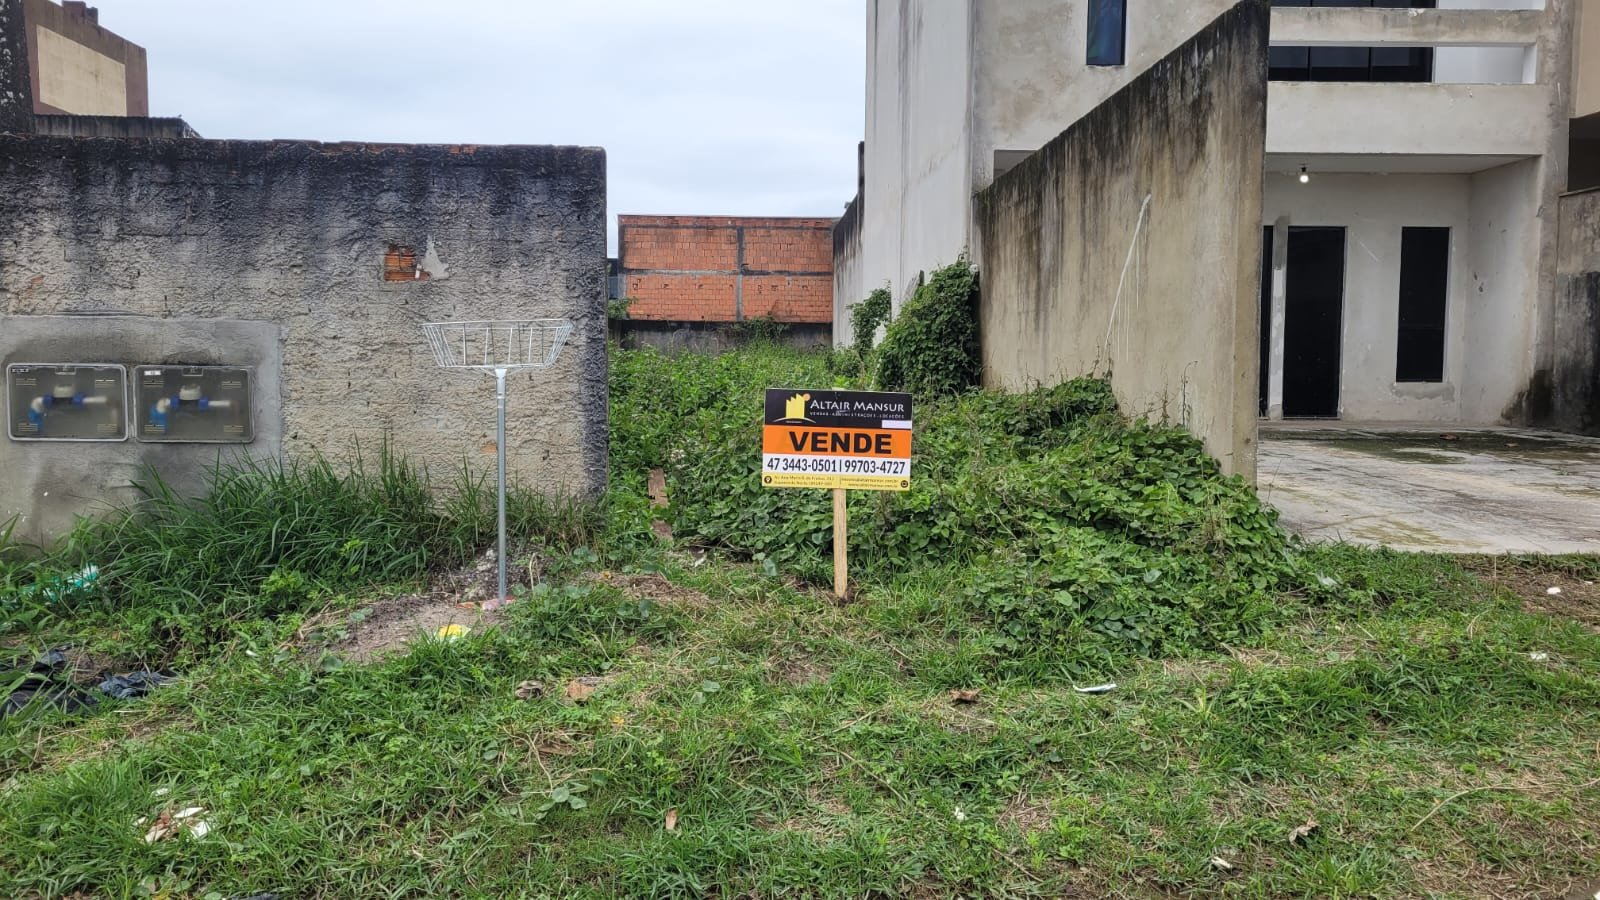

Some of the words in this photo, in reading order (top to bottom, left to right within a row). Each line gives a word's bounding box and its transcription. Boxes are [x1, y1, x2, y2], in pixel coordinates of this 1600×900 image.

[810, 399, 850, 410] ALTAIR
[853, 401, 905, 412] MANSUR
[789, 431, 892, 454] VENDE
[767, 458, 780, 471] 47
[782, 458, 837, 472] 3443-0501
[845, 460, 905, 474] 99703-4727
